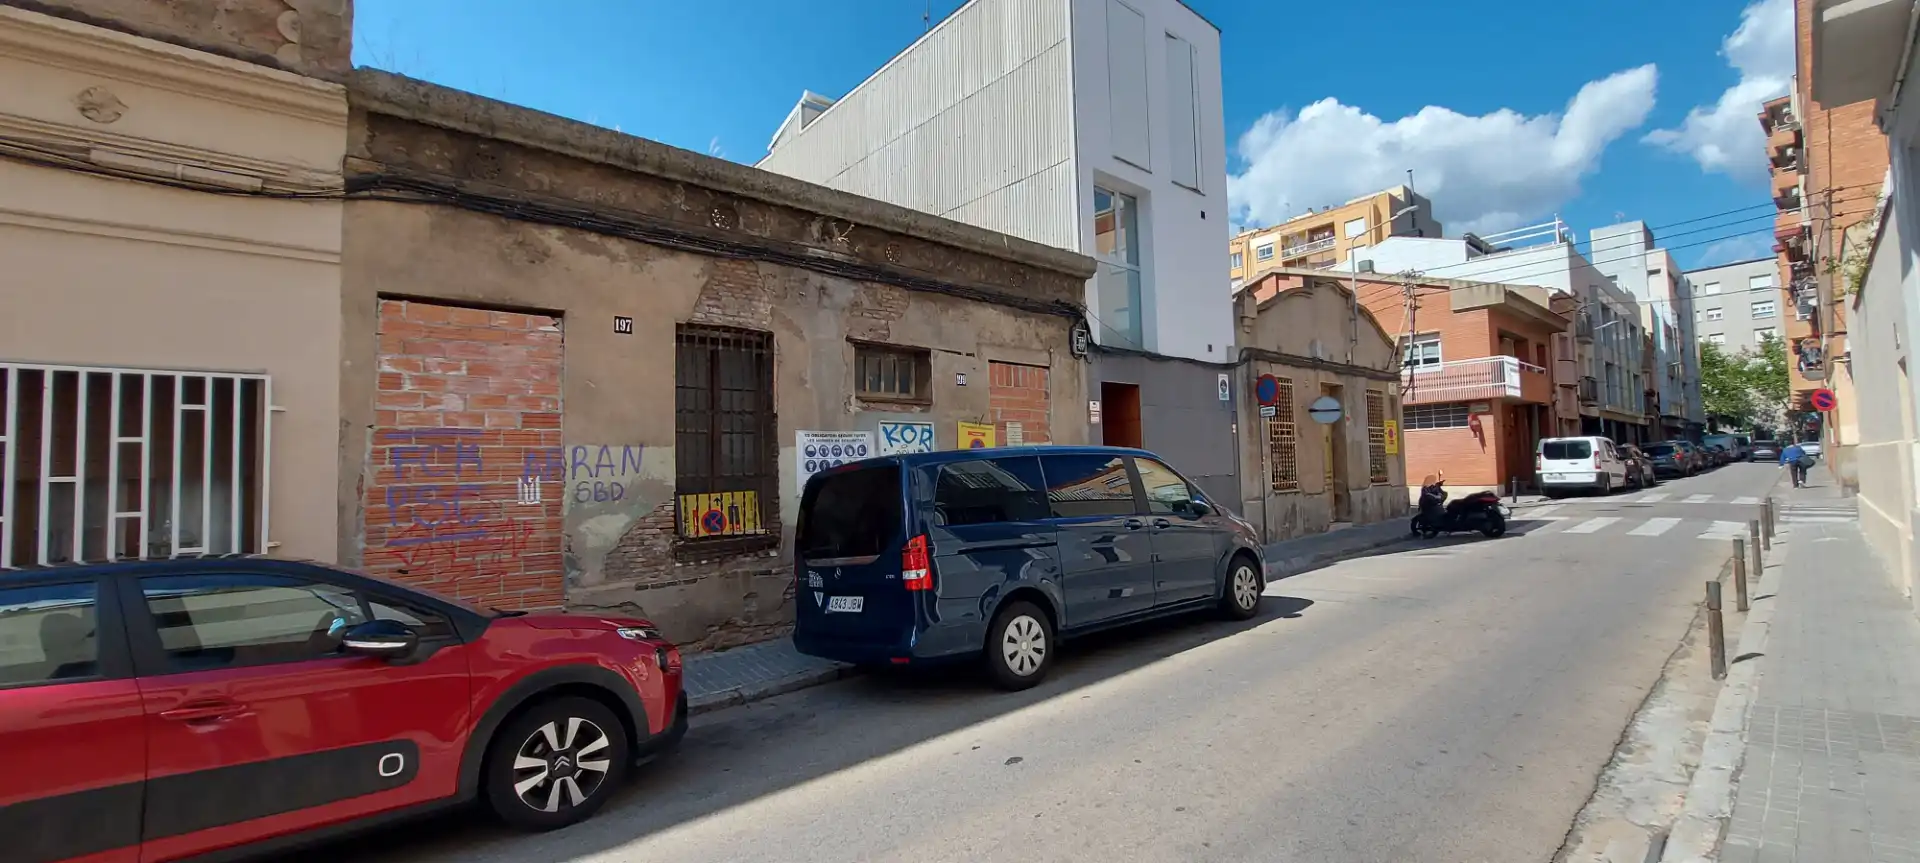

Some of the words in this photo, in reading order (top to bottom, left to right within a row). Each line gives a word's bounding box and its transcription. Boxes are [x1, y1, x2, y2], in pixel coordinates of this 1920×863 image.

[615, 318, 632, 332] 197
[882, 423, 933, 451] KOR
[575, 480, 624, 503] SBD
[385, 484, 484, 526] PSC
